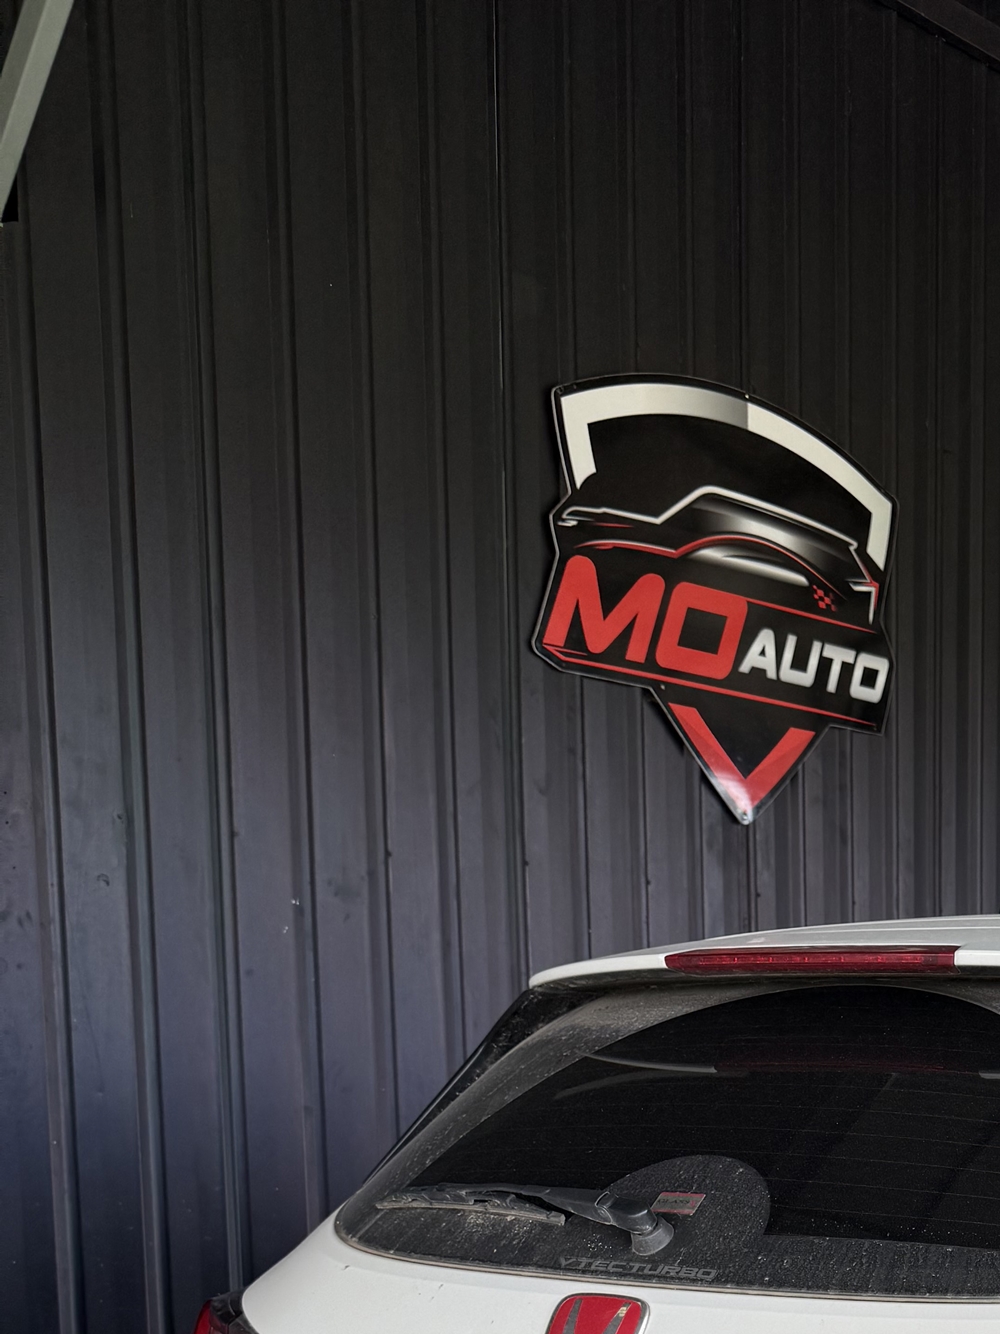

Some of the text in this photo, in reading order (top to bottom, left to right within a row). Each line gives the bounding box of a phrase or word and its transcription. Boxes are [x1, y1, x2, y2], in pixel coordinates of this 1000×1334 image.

[542, 555, 890, 703] MO AUTO
[629, 1262, 719, 1281] TURBO
